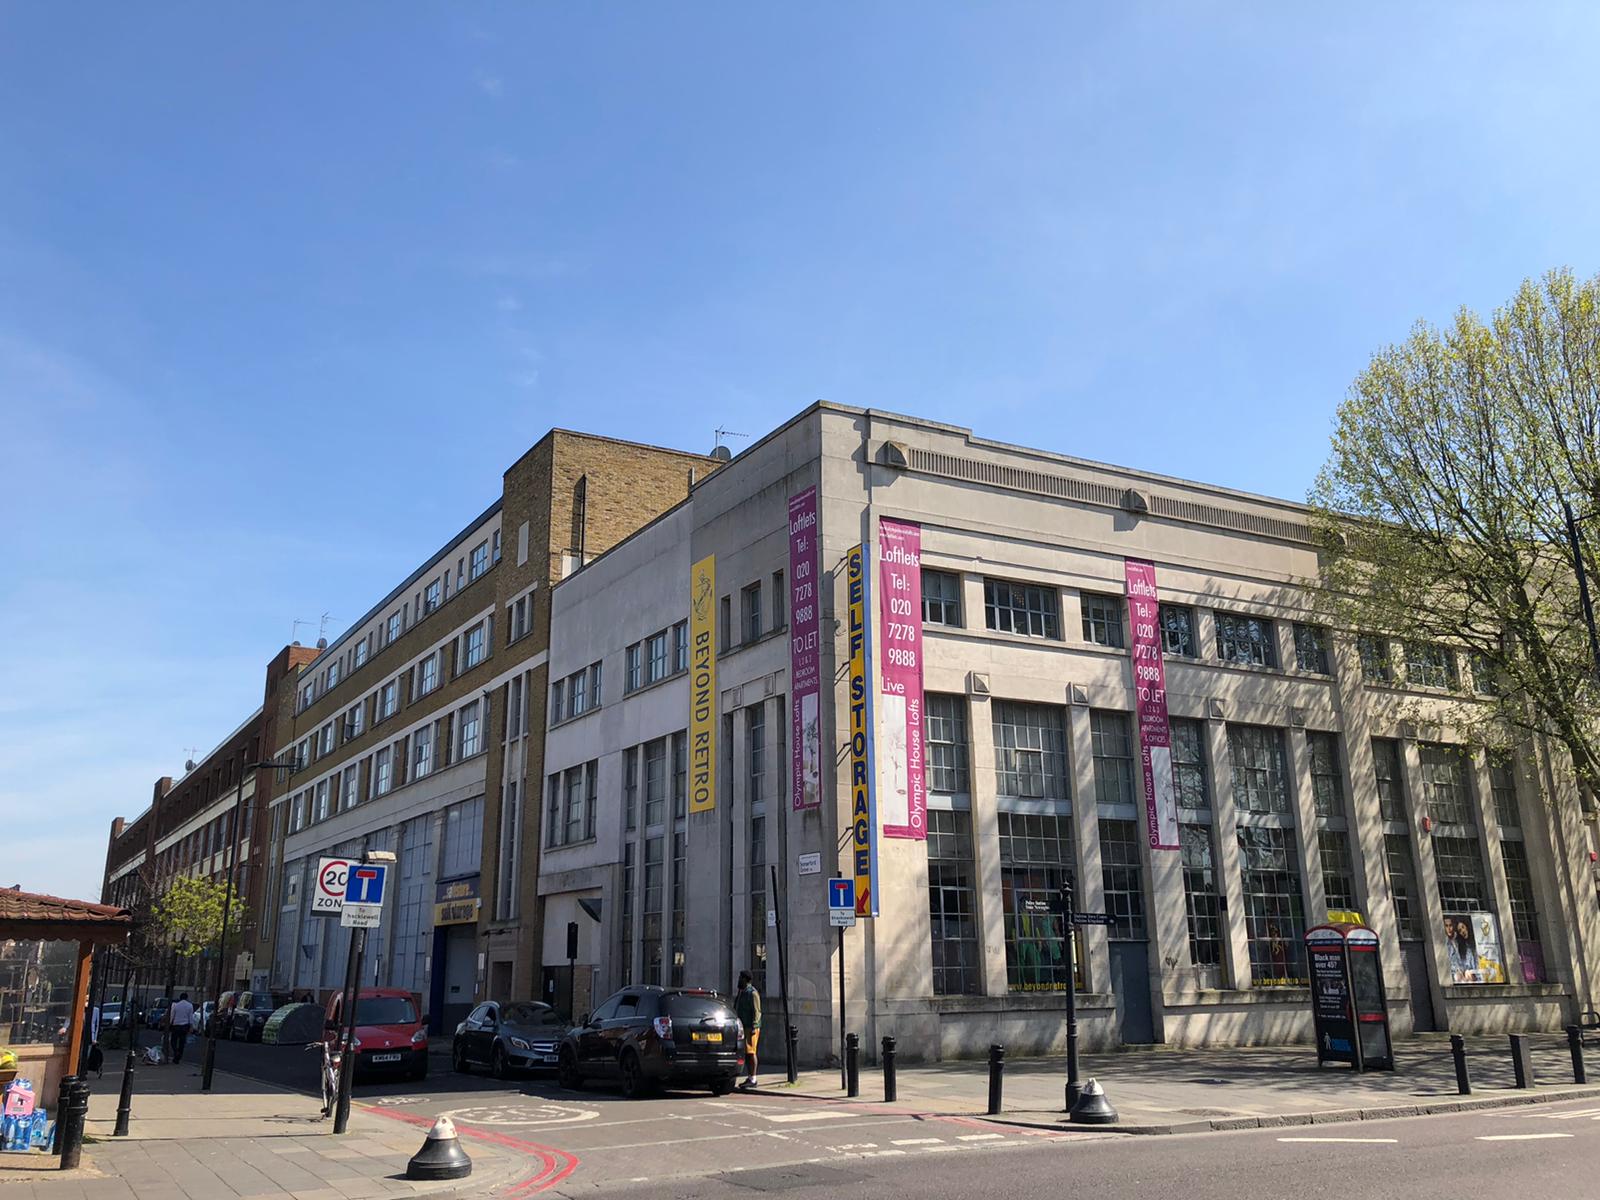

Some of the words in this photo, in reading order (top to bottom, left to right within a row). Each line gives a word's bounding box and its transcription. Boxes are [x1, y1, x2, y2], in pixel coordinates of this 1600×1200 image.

[790, 512, 816, 536] Loftlets
[796, 536, 808, 554] Tel:
[880, 544, 919, 567] Loftlets
[796, 561, 810, 579] 020
[795, 582, 812, 602] 7278
[891, 573, 910, 592] Tel:
[1128, 578, 1156, 597] Loftlets
[796, 604, 812, 624] 9888
[850, 553, 862, 660] SELF
[891, 598, 911, 616] 020
[1136, 602, 1152, 618] Tel:
[888, 622, 914, 642] 7278
[1136, 623, 1154, 638] 020
[793, 636, 804, 654] TO
[804, 631, 817, 650] LET
[1136, 644, 1158, 660] 7278
[888, 648, 916, 667] 9888
[695, 631, 710, 722] BEYOND
[1138, 666, 1160, 682] 9888
[881, 676, 904, 694] Live
[1138, 687, 1150, 701] TO
[1152, 689, 1164, 703] LET
[908, 698, 920, 726] Lofts
[910, 730, 920, 768] House
[1142, 745, 1150, 766] Lofts
[694, 731, 710, 803] RETRO
[852, 676, 868, 876] STORAGE
[910, 773, 924, 828] Olympic
[1150, 805, 1159, 846] Olympic
[318, 898, 342, 908] ZON
